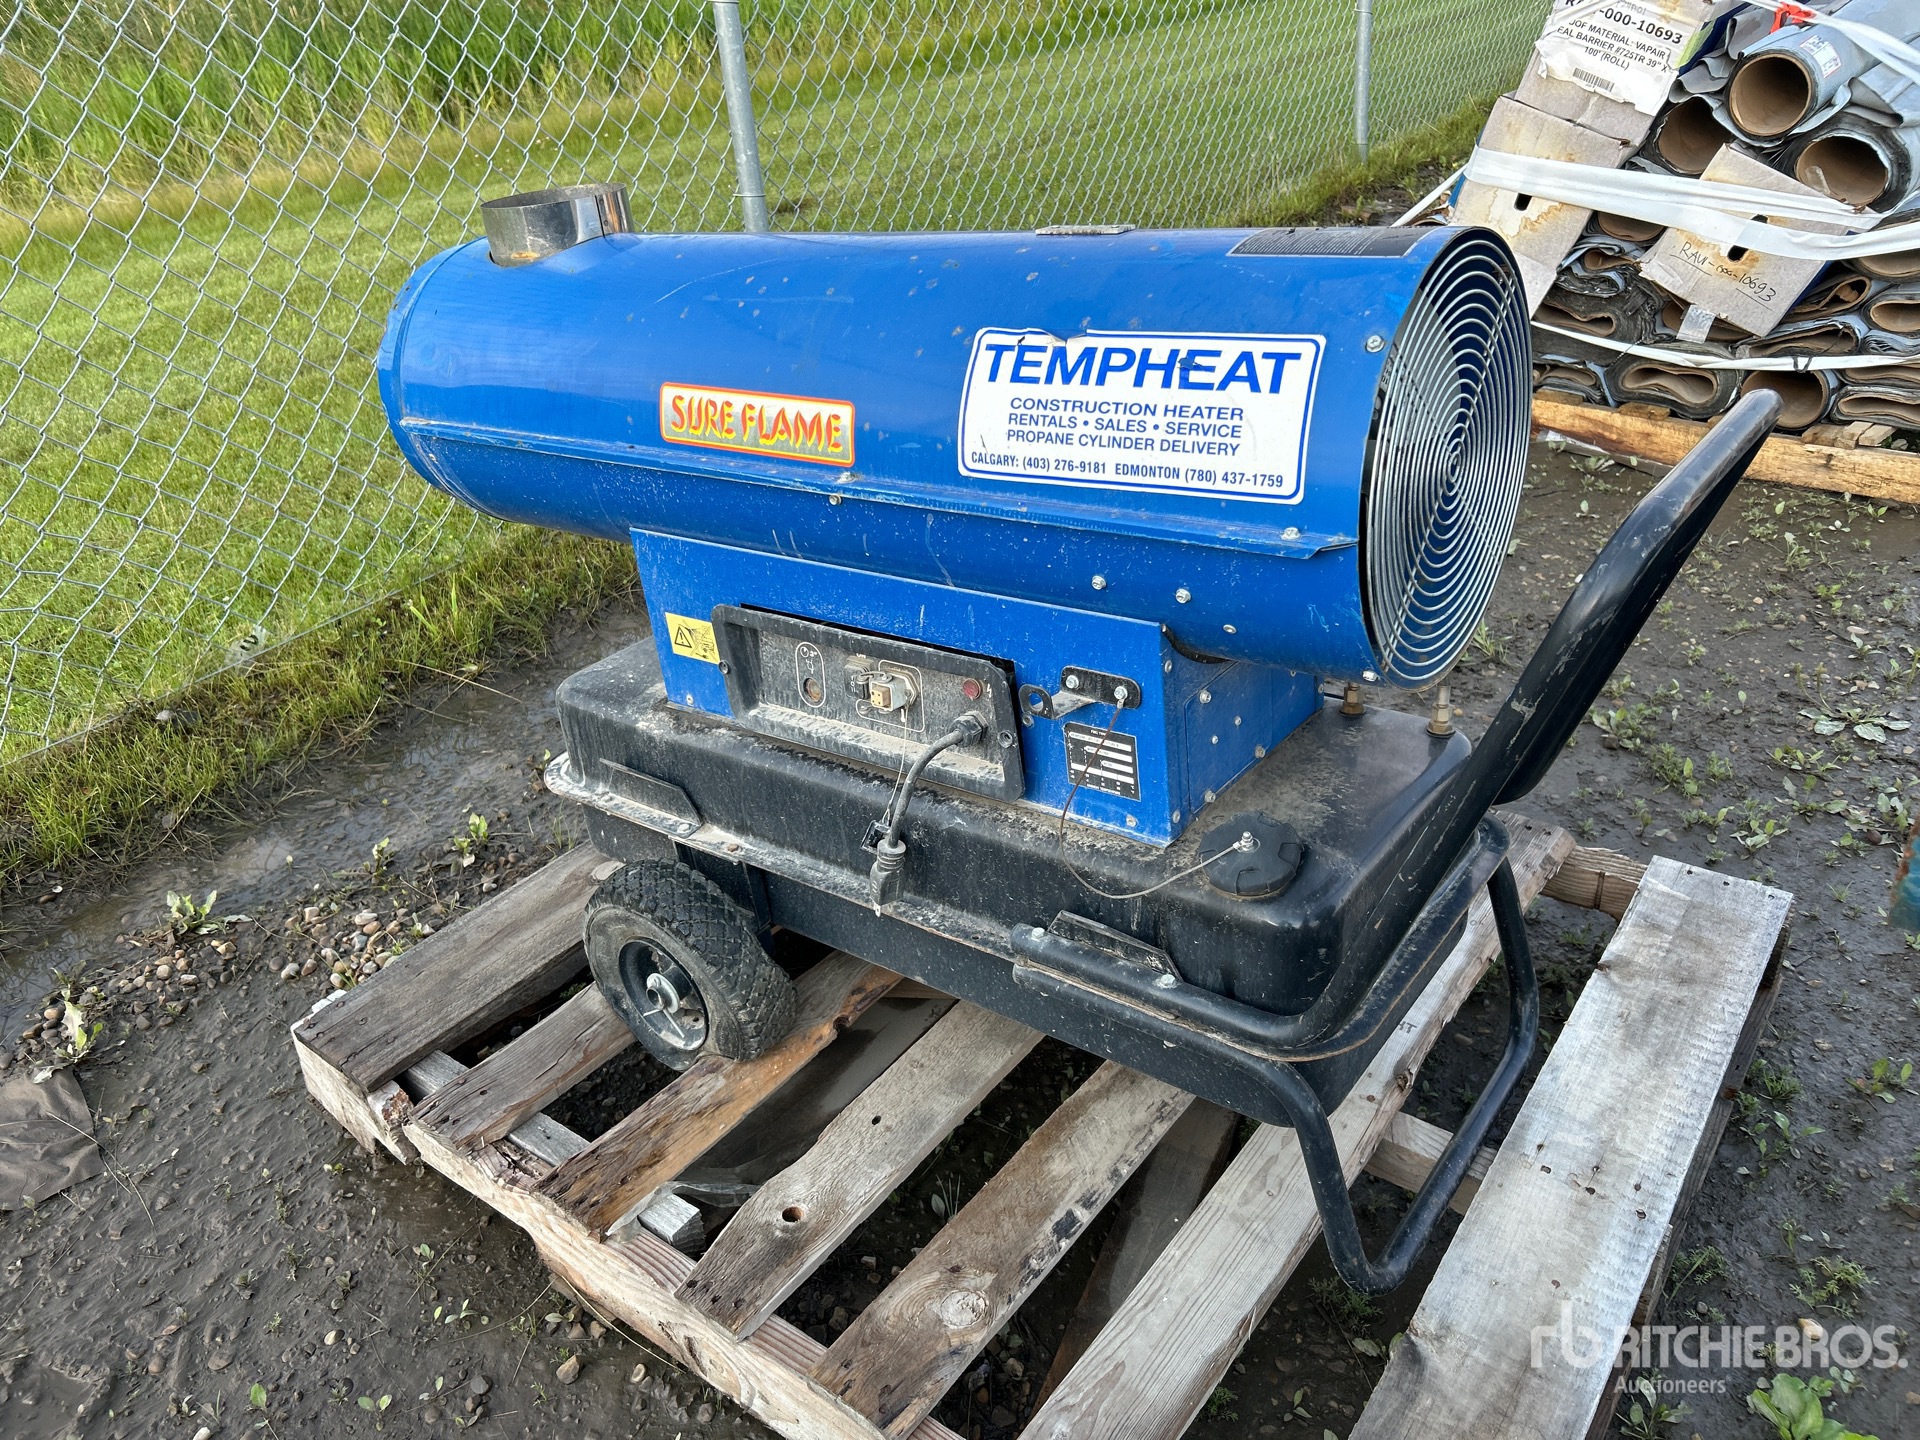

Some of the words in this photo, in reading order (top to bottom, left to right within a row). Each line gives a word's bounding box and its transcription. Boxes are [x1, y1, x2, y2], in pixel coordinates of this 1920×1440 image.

[1557, 25, 1574, 37] EAL
[1575, 31, 1615, 50] BARRIER
[1615, 46, 1646, 64] #725TR
[1646, 58, 1661, 68] 39"
[1661, 65, 1668, 73] X
[1584, 46, 1600, 57] 100'
[1600, 51, 1630, 70] (ROLL)
[1588, 24, 1634, 46] MATERIAL:
[1635, 41, 1666, 59] VAPAIR
[985, 343, 1302, 394] TEMPHEAT
[671, 395, 736, 439] SURE
[741, 402, 843, 453] FLAME
[1008, 413, 1077, 429] RENTALS
[1094, 418, 1147, 433] SALES
[1164, 421, 1242, 438] SERVICE
[1010, 397, 1157, 417] CONSTRUCTION
[1163, 403, 1244, 421] HEATER
[1007, 429, 1074, 445] PROPANE
[1078, 433, 1154, 451] CYLINDER
[1160, 439, 1241, 456] DELIVERY
[971, 451, 1019, 467] CALGARY:
[1022, 457, 1051, 472] (403)
[1054, 459, 1107, 474] 276-9181
[1115, 462, 1180, 480] EDMONTON
[1185, 468, 1217, 485] (780)
[1221, 471, 1284, 487] 437-1759
